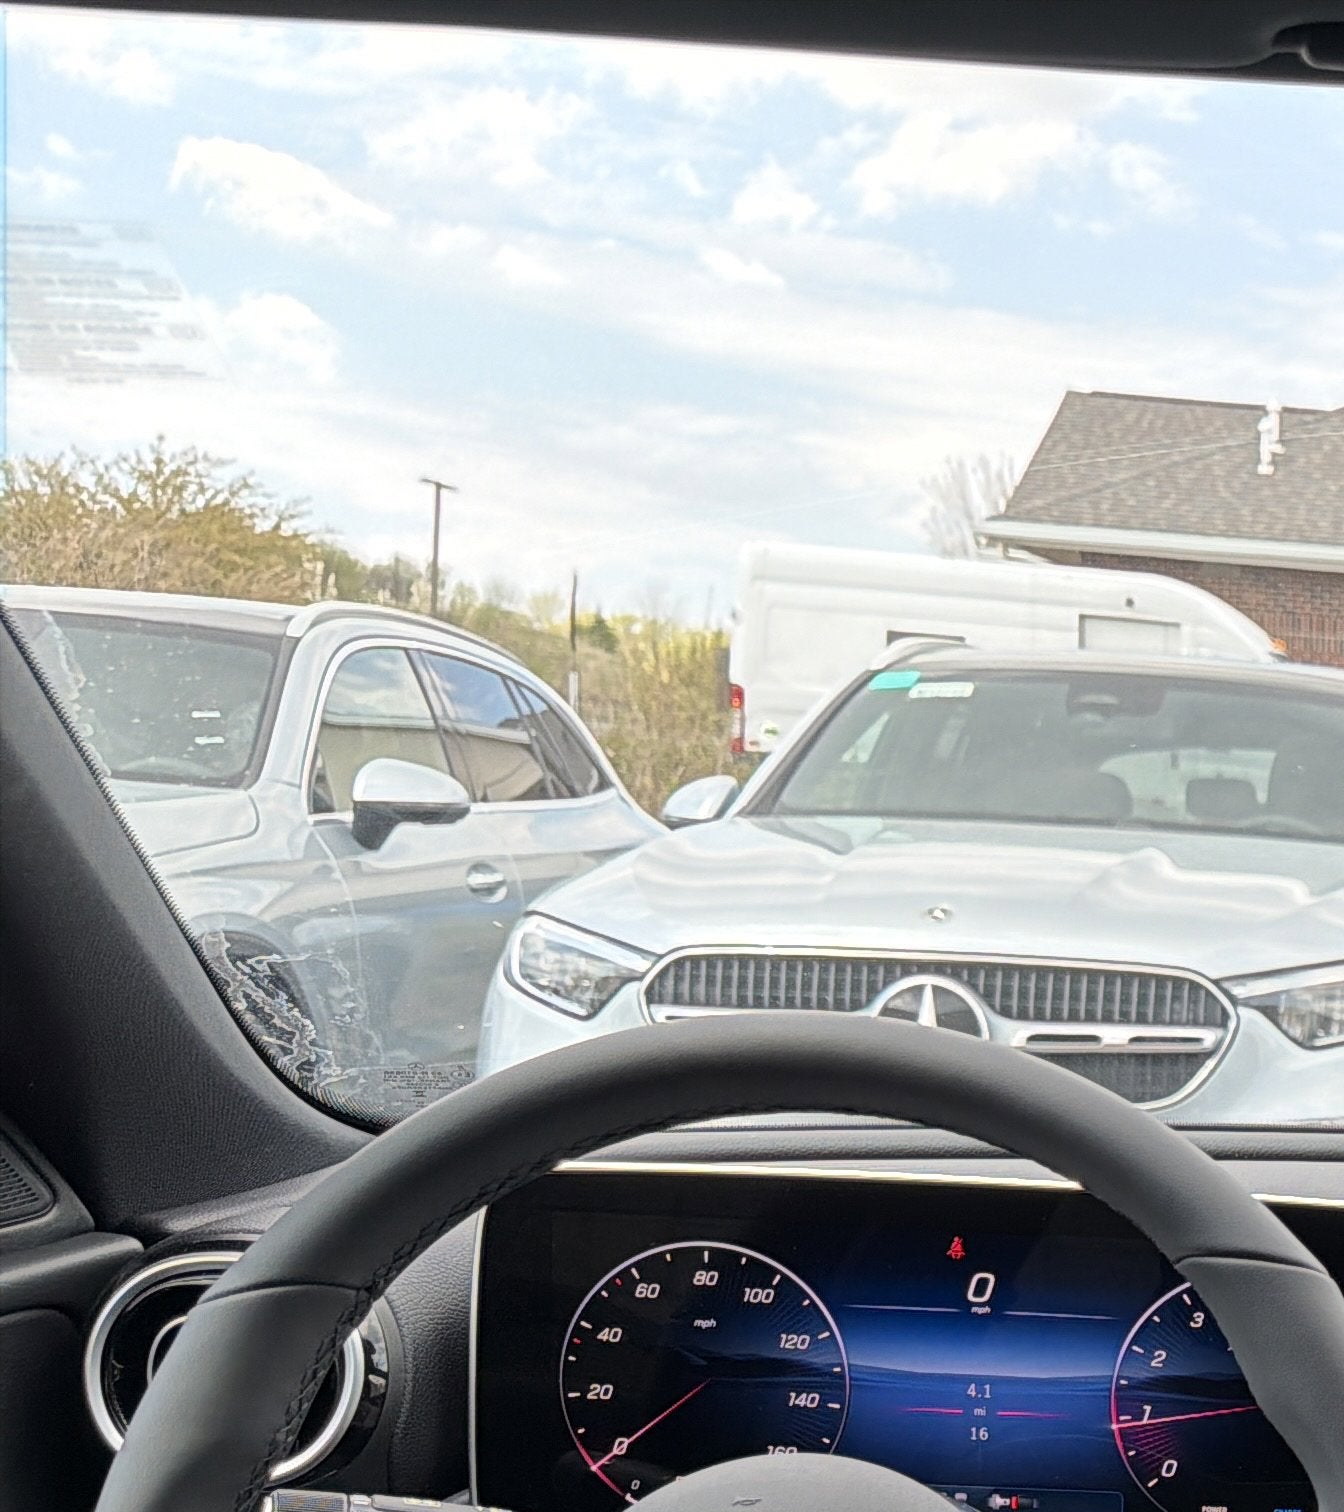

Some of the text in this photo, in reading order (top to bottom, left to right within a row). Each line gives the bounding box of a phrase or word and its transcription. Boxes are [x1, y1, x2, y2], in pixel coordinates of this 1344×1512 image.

[693, 1271, 719, 1287] 80
[634, 1283, 661, 1299] 60
[743, 1287, 775, 1304] 100
[966, 1272, 996, 1303] 0
[693, 1318, 717, 1330] mph
[1189, 1312, 1205, 1328] 3
[597, 1327, 623, 1343] 40
[779, 1333, 811, 1350] 120
[1150, 1351, 1167, 1368] 2
[586, 1384, 614, 1401] 20
[966, 1383, 992, 1399] 4.1
[788, 1392, 820, 1408] 140
[974, 1405, 987, 1417] mi
[1141, 1405, 1151, 1423] 1
[970, 1426, 989, 1442] 16
[613, 1437, 629, 1456] 0
[1161, 1460, 1178, 1478] 0
